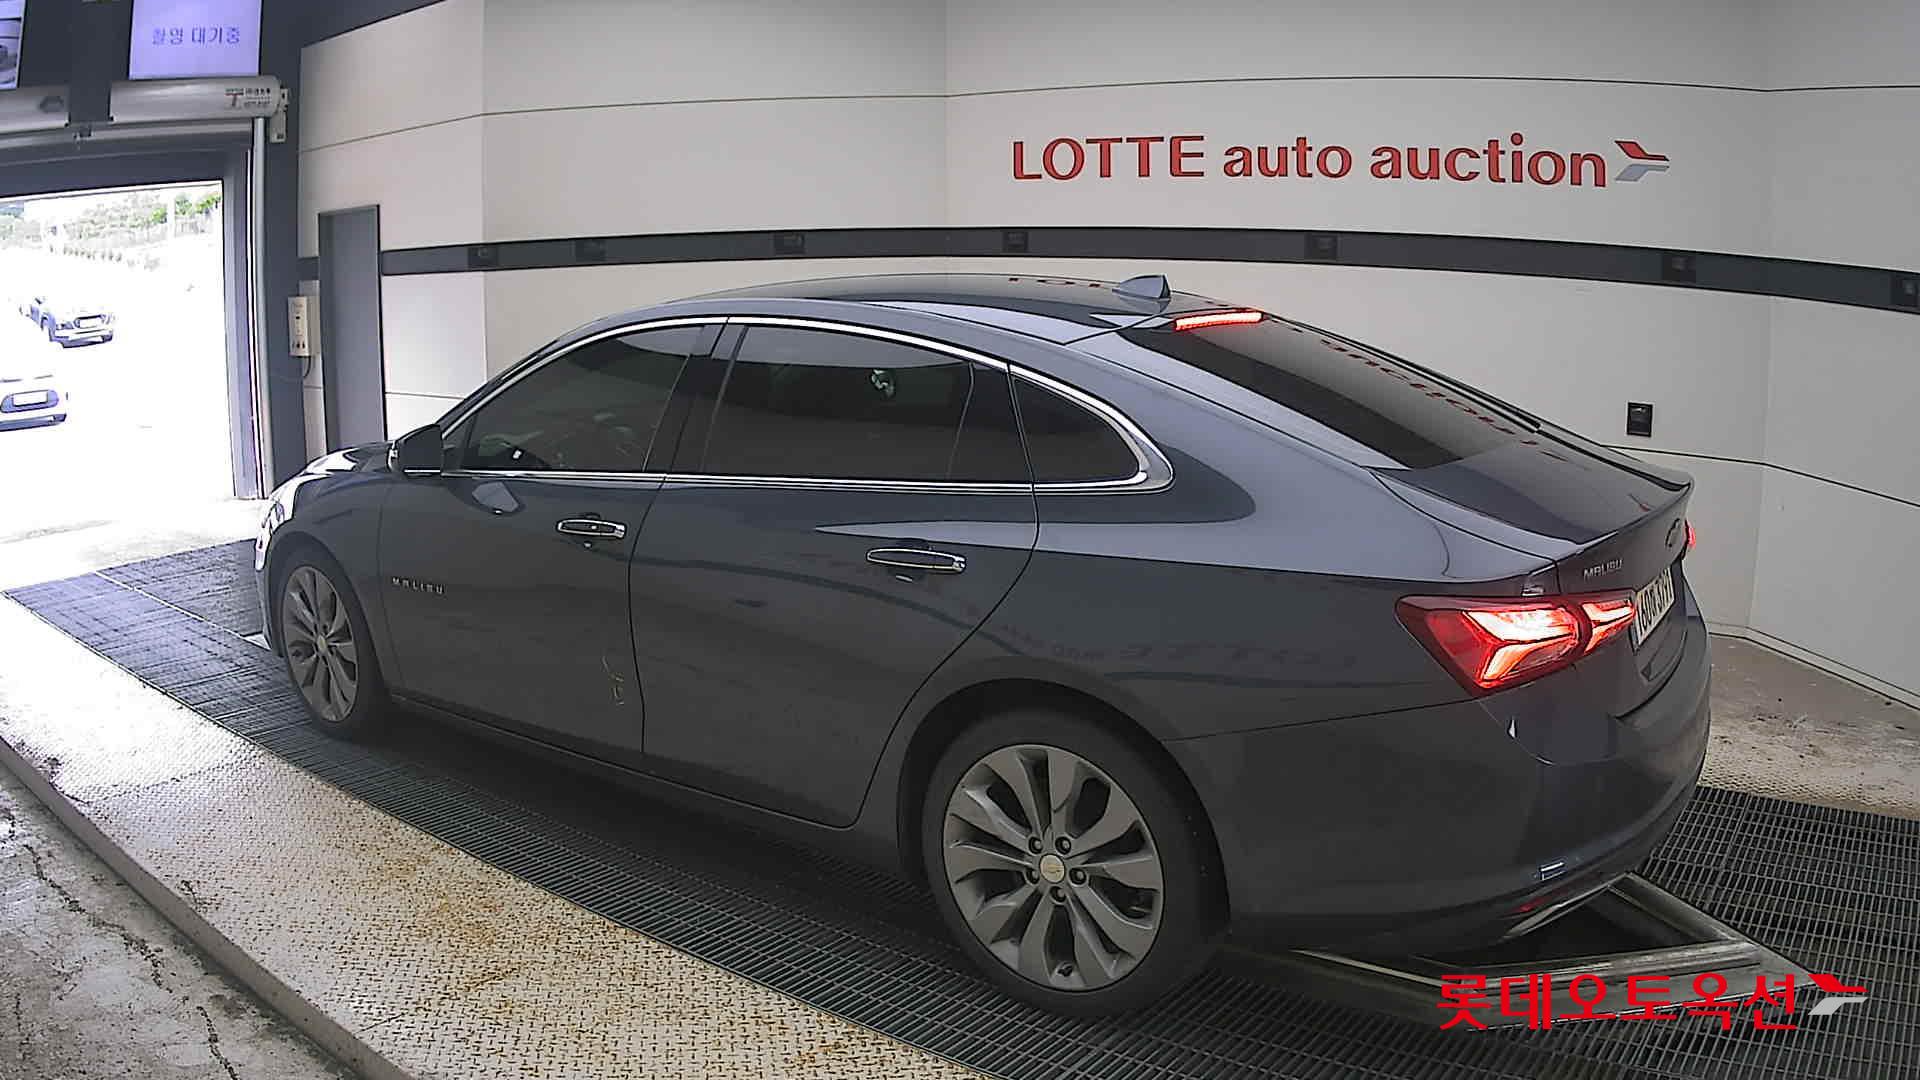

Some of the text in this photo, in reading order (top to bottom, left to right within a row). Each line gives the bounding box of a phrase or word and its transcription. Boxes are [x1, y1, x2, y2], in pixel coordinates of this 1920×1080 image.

[191, 26, 240, 44] 대기중
[1013, 132, 1607, 187] LOTTE auto auction
